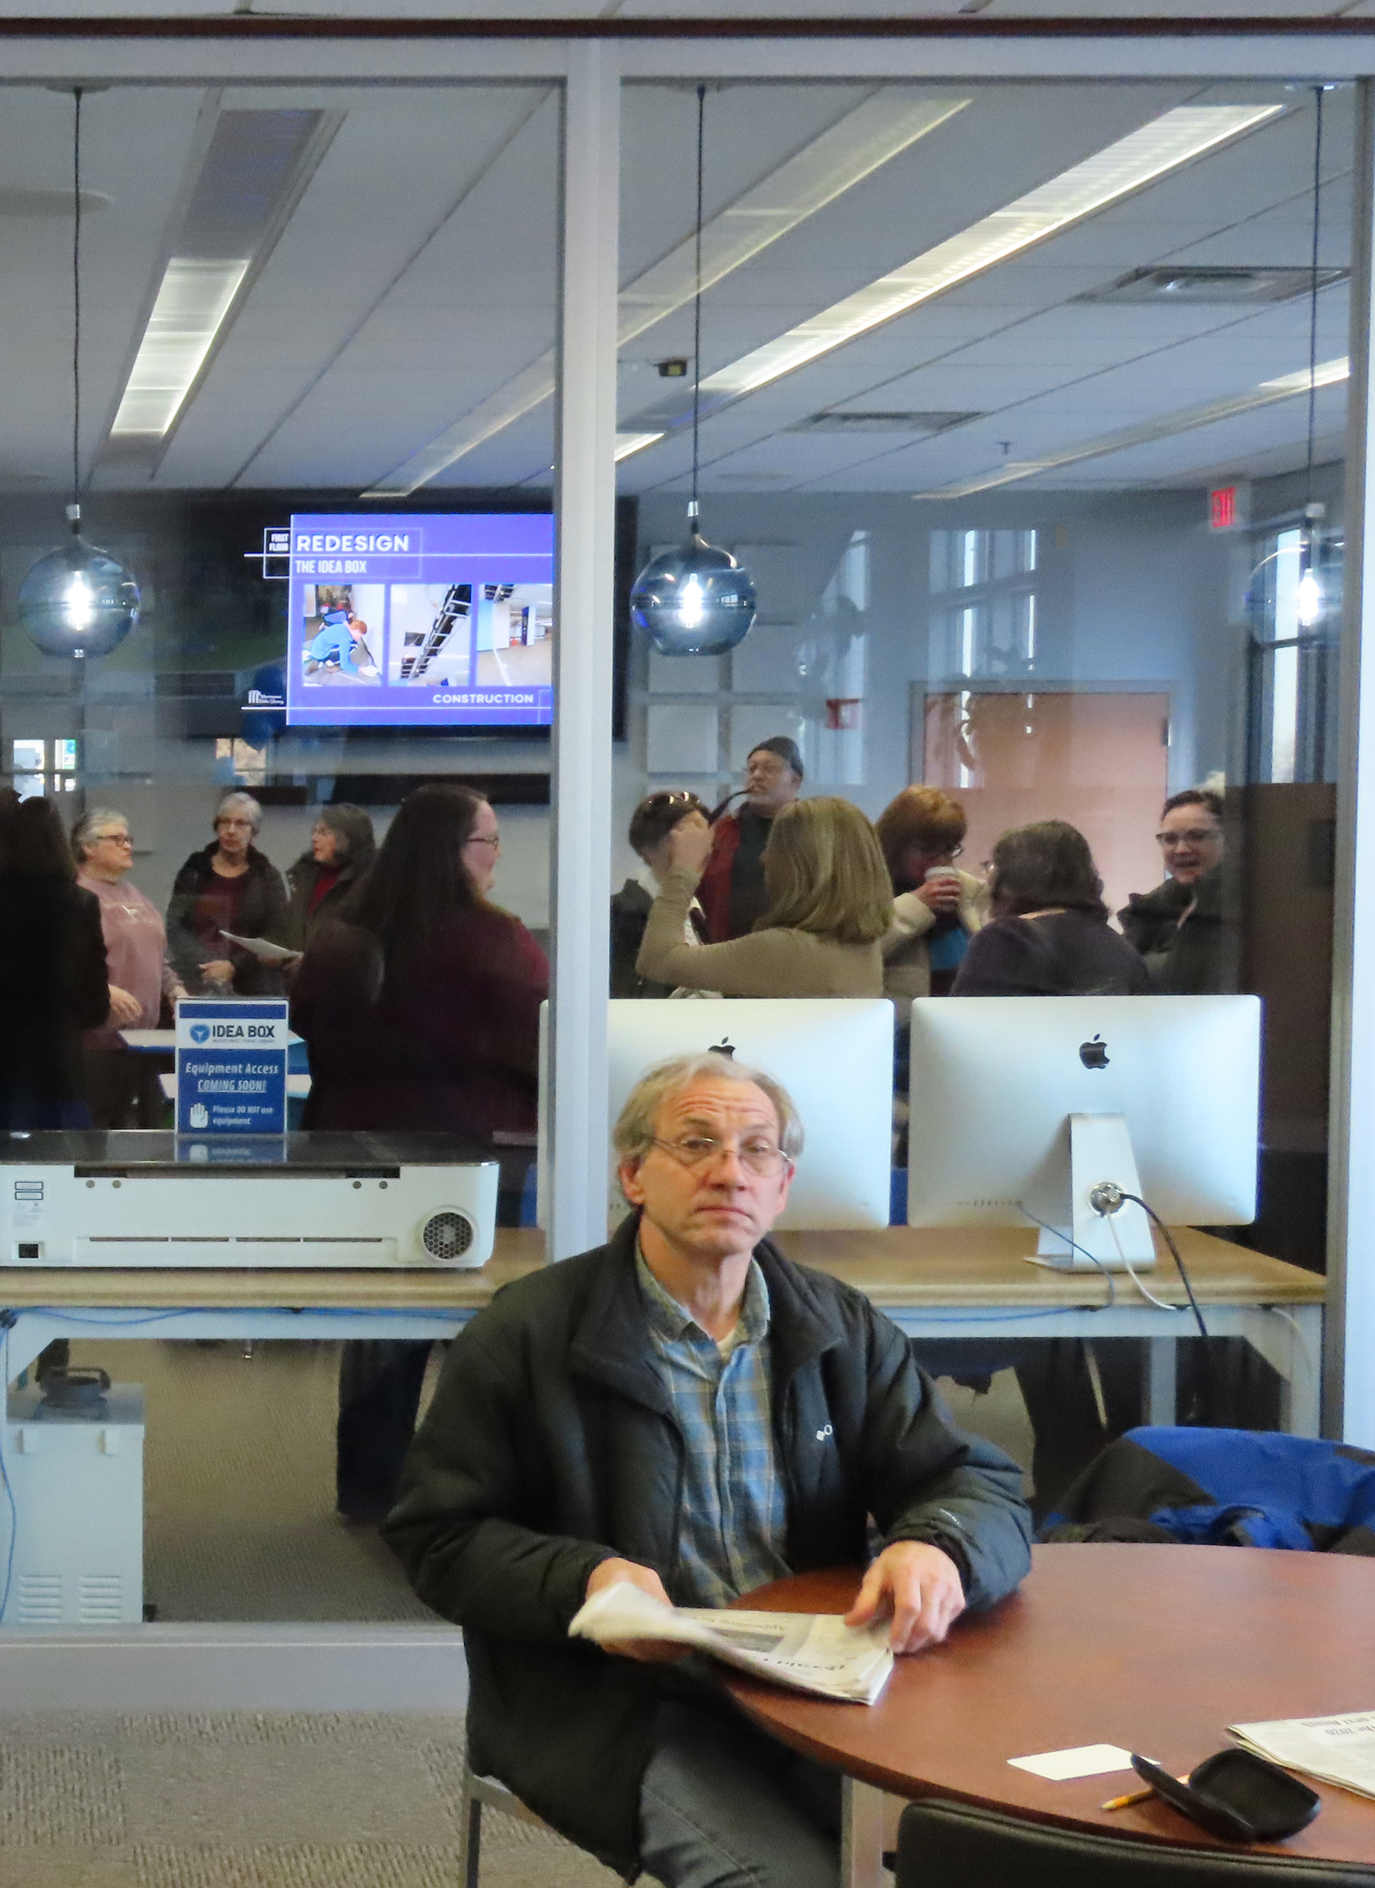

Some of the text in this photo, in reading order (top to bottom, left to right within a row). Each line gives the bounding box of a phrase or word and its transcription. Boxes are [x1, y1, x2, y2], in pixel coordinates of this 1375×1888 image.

[296, 534, 409, 552] REDESIGN
[295, 560, 367, 574] THE IDEA BOX
[432, 693, 534, 704] CONSTRUCTION
[212, 1025, 275, 1038] IDEA BOX
[186, 1063, 279, 1076] Equipment Access
[198, 1079, 266, 1092] COMING SOON!
